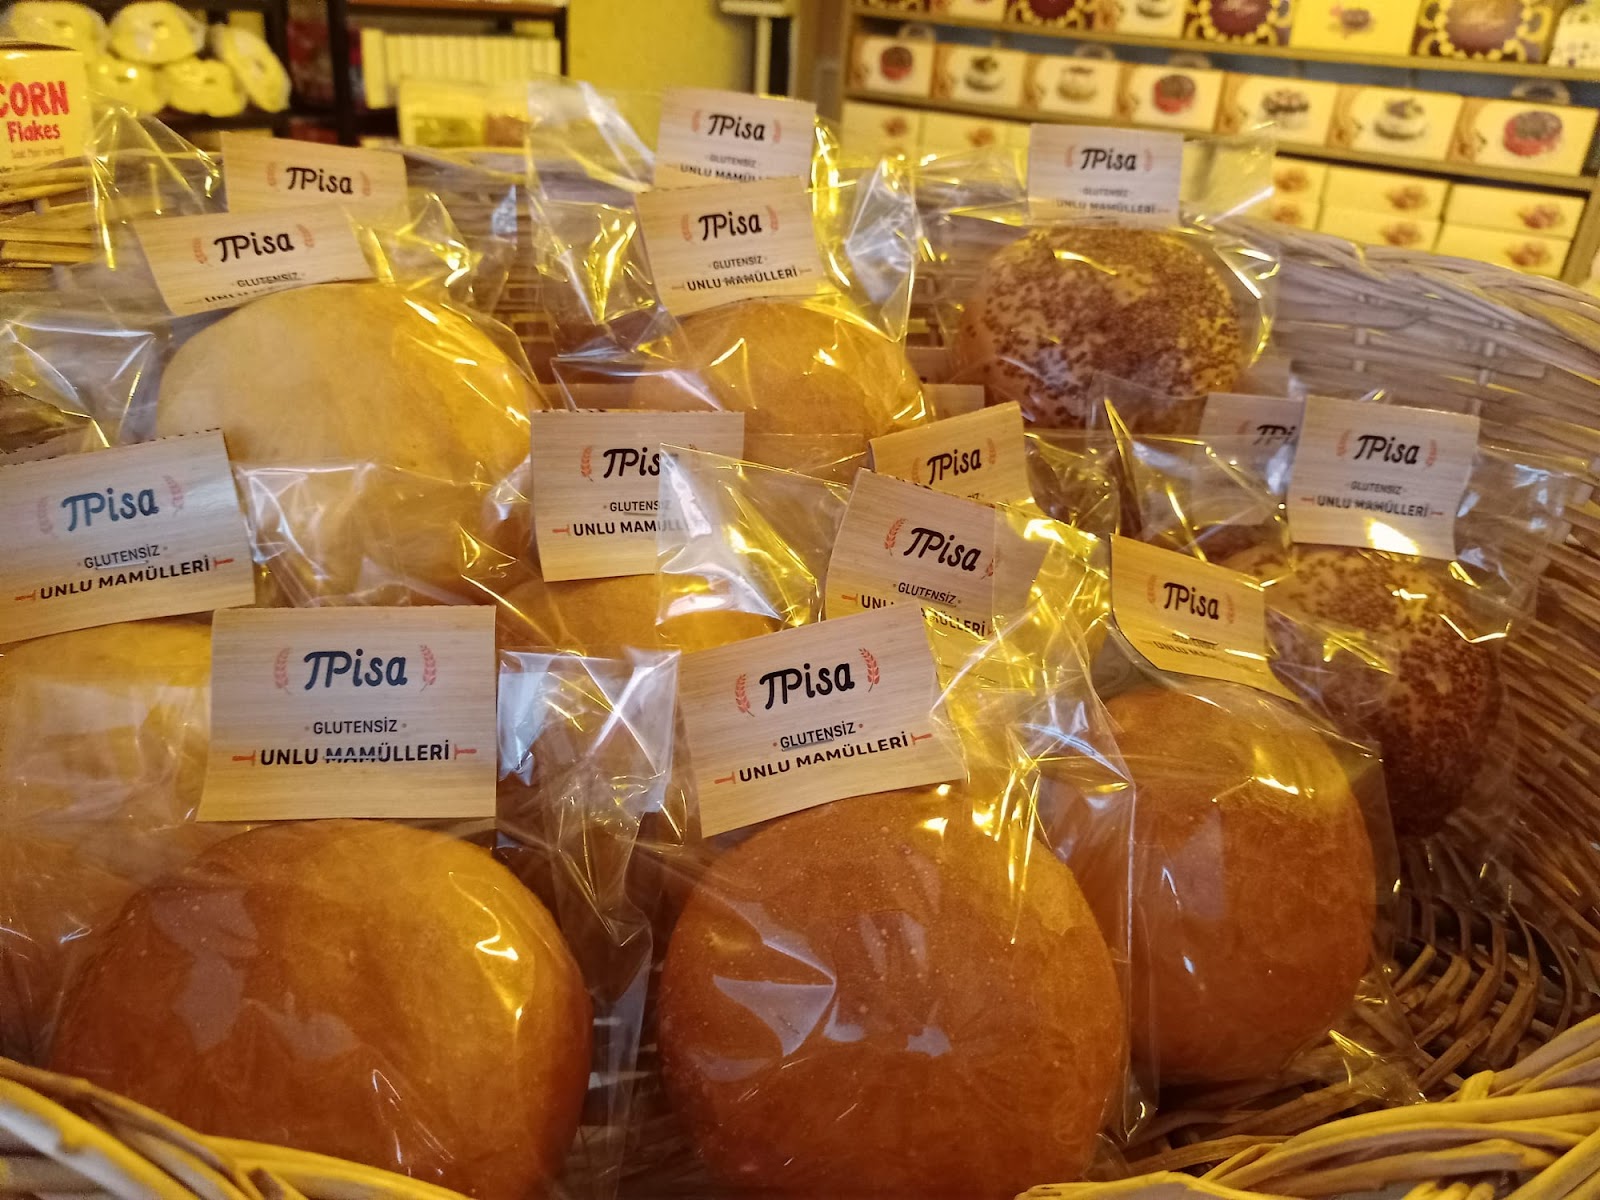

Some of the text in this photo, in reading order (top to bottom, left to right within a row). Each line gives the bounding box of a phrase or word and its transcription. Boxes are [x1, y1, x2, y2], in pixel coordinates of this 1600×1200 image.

[7, 120, 60, 143] Flakes
[686, 277, 722, 292] UNLU
[1316, 495, 1352, 509] UNLU
[573, 521, 616, 536] UNLU
[83, 543, 161, 570] GLUTENSİZ
[40, 555, 210, 600] UNLU MAMÜLLERİ
[313, 717, 398, 735] GLUTENSİZ
[780, 720, 856, 749] GLUTENSİZ
[260, 739, 450, 766] UNLU MAMÜLLERİ
[739, 731, 909, 782] UNLU MAMÜLLERİ
